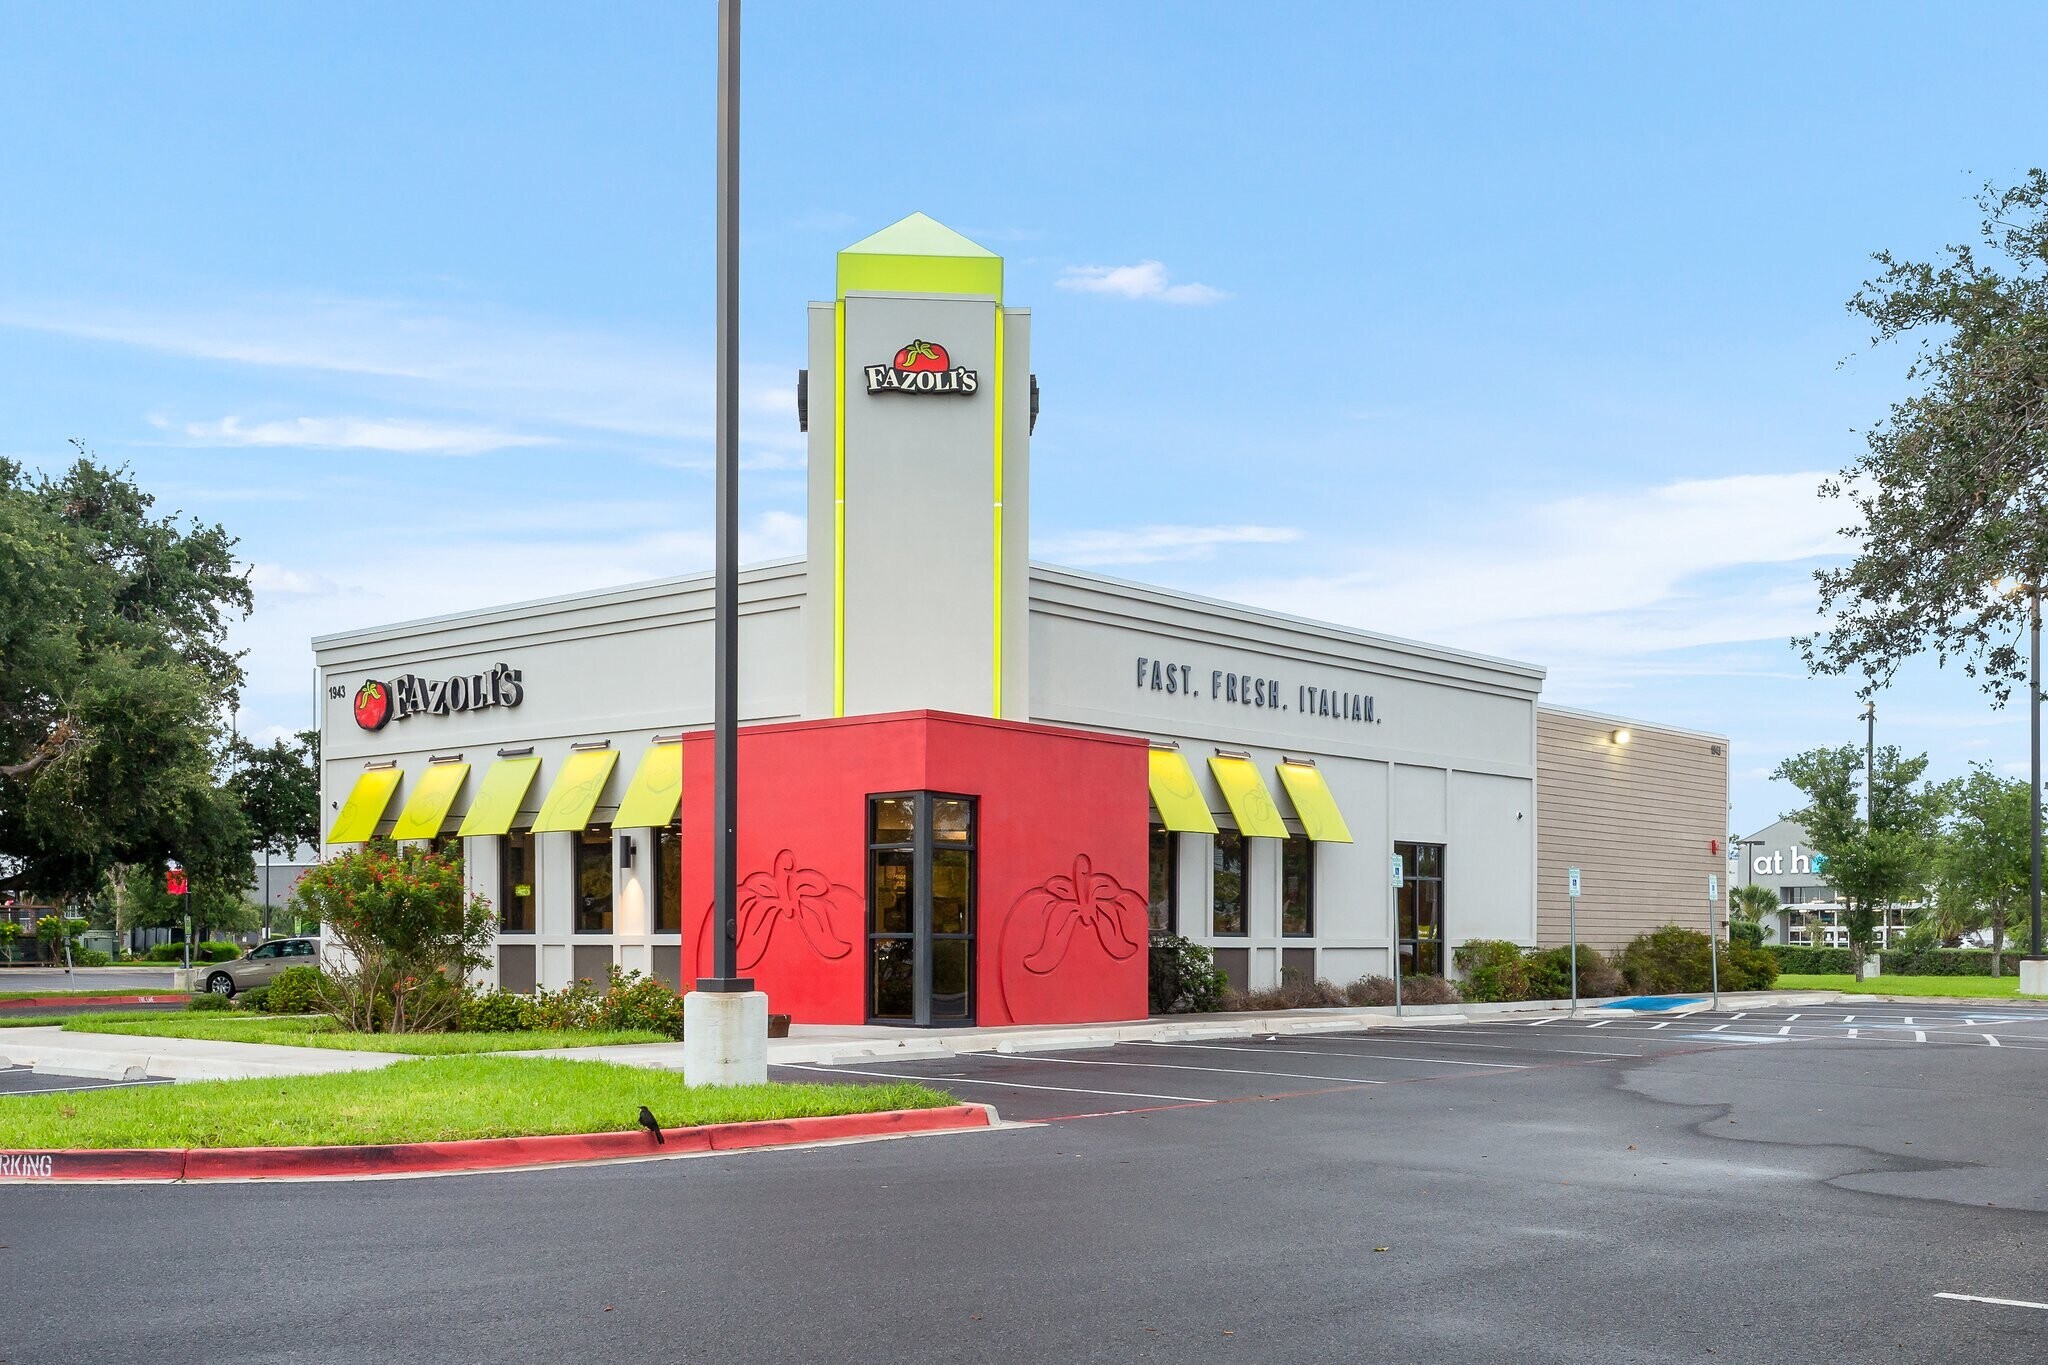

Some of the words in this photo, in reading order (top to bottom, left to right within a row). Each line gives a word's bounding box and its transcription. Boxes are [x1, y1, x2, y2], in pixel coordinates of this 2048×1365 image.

[865, 365, 978, 393] FAZOLI'S
[328, 684, 346, 700] 1943
[388, 662, 524, 721] FAZOLI'S
[1137, 656, 1199, 697] FAST.
[1212, 670, 1288, 711] FRESH.
[1299, 685, 1382, 724] ITALIAN.
[1753, 850, 1784, 875] at
